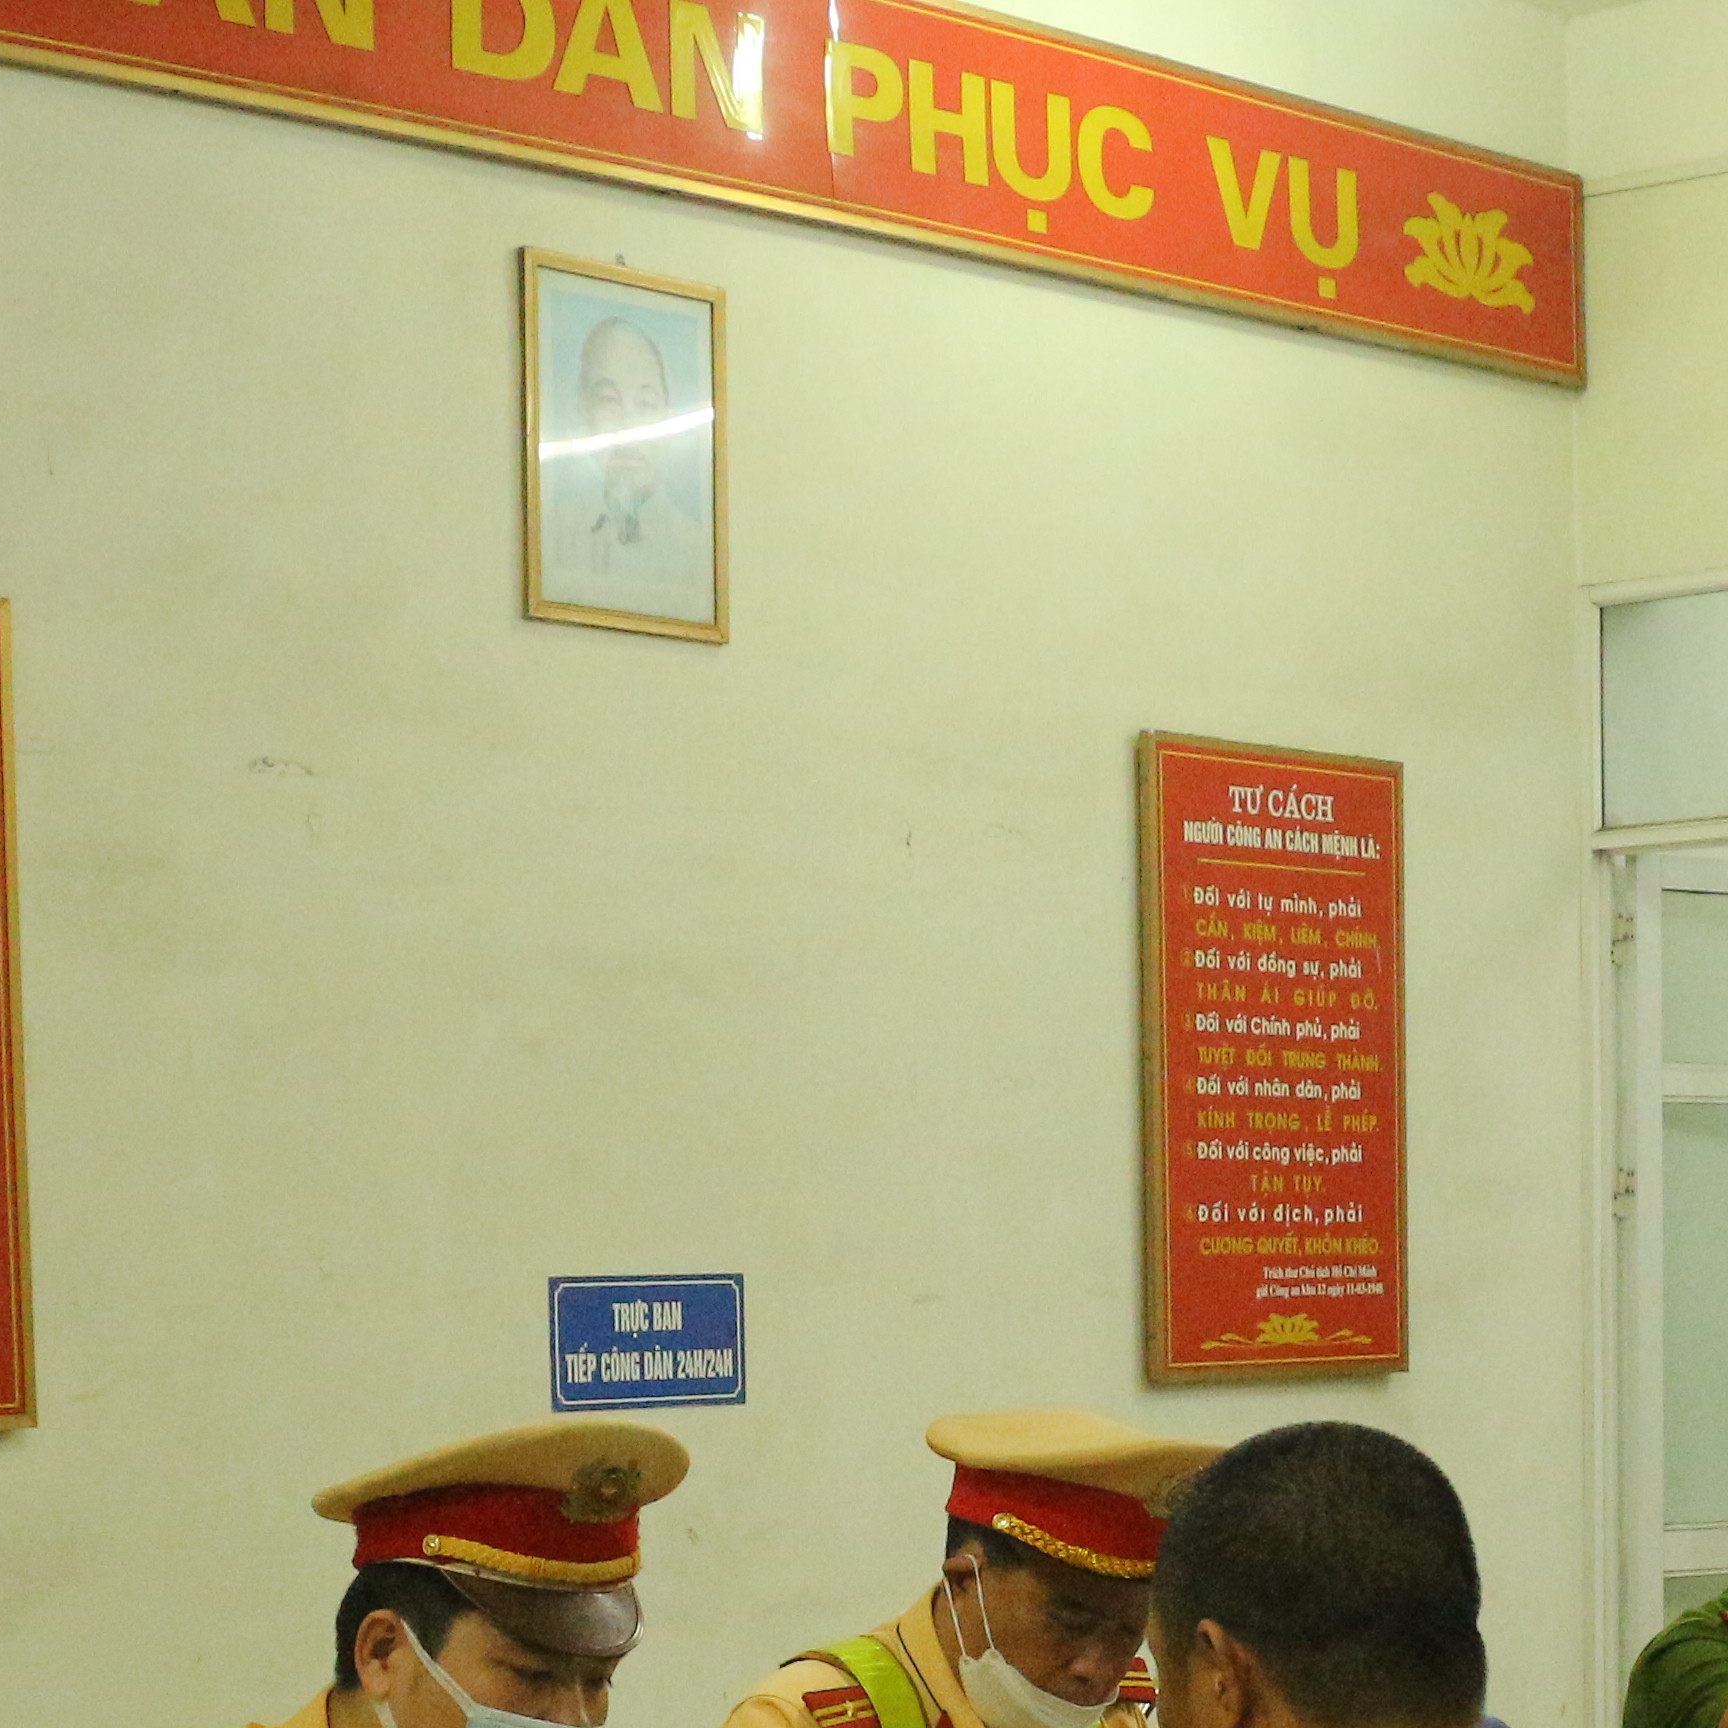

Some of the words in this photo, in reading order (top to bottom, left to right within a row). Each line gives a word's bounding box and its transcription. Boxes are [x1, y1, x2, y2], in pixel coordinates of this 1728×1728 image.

[825, 38, 1154, 233] PHỤC
[1205, 135, 1359, 299] VỤ
[1228, 784, 1264, 815] TƯ
[1268, 783, 1334, 822] CÁCH
[1183, 817, 1223, 844] NGƯỜI
[1227, 820, 1262, 848] CÔNG
[1265, 829, 1283, 849] AN
[1286, 825, 1319, 854] CÁCH
[1322, 830, 1358, 860] MỆNH
[1361, 833, 1381, 859] LÀ:
[1193, 885, 1220, 905] Đối
[1227, 887, 1251, 908] với
[1258, 892, 1274, 916] tự
[1280, 892, 1324, 917] mình,
[1328, 896, 1363, 919] phải
[1194, 947, 1221, 969] Đối
[1228, 950, 1252, 971] với
[1258, 950, 1297, 978] đồng
[1303, 959, 1325, 980] sự,
[1330, 956, 1363, 979] phải
[1195, 1011, 1221, 1032] Đối
[1225, 1013, 1248, 1034] với
[1250, 1014, 1291, 1036] Chính
[1295, 1018, 1327, 1041] phủ,
[1330, 1018, 1361, 1041] phải
[1196, 1073, 1221, 1095] Đối
[1228, 1075, 1250, 1096] với
[1254, 1077, 1290, 1097] nhân
[1295, 1079, 1328, 1101] dân,
[1331, 1079, 1362, 1102] phải
[1196, 1138, 1223, 1160] Đối
[1226, 1141, 1249, 1161] với
[1253, 1142, 1290, 1166] công
[1294, 1143, 1329, 1168] việc,
[1331, 1140, 1363, 1165] phải
[1197, 1200, 1230, 1222] Đối
[1236, 1202, 1266, 1222] với
[1273, 1203, 1320, 1227] địch,
[1324, 1201, 1364, 1225] phải
[612, 1299, 650, 1338] TRỰC
[653, 1301, 683, 1331] BAN
[565, 1342, 597, 1383] TIẾP
[601, 1346, 640, 1382] CÔNG
[643, 1345, 673, 1381] DÂN
[677, 1348, 733, 1379] 24H/24H
